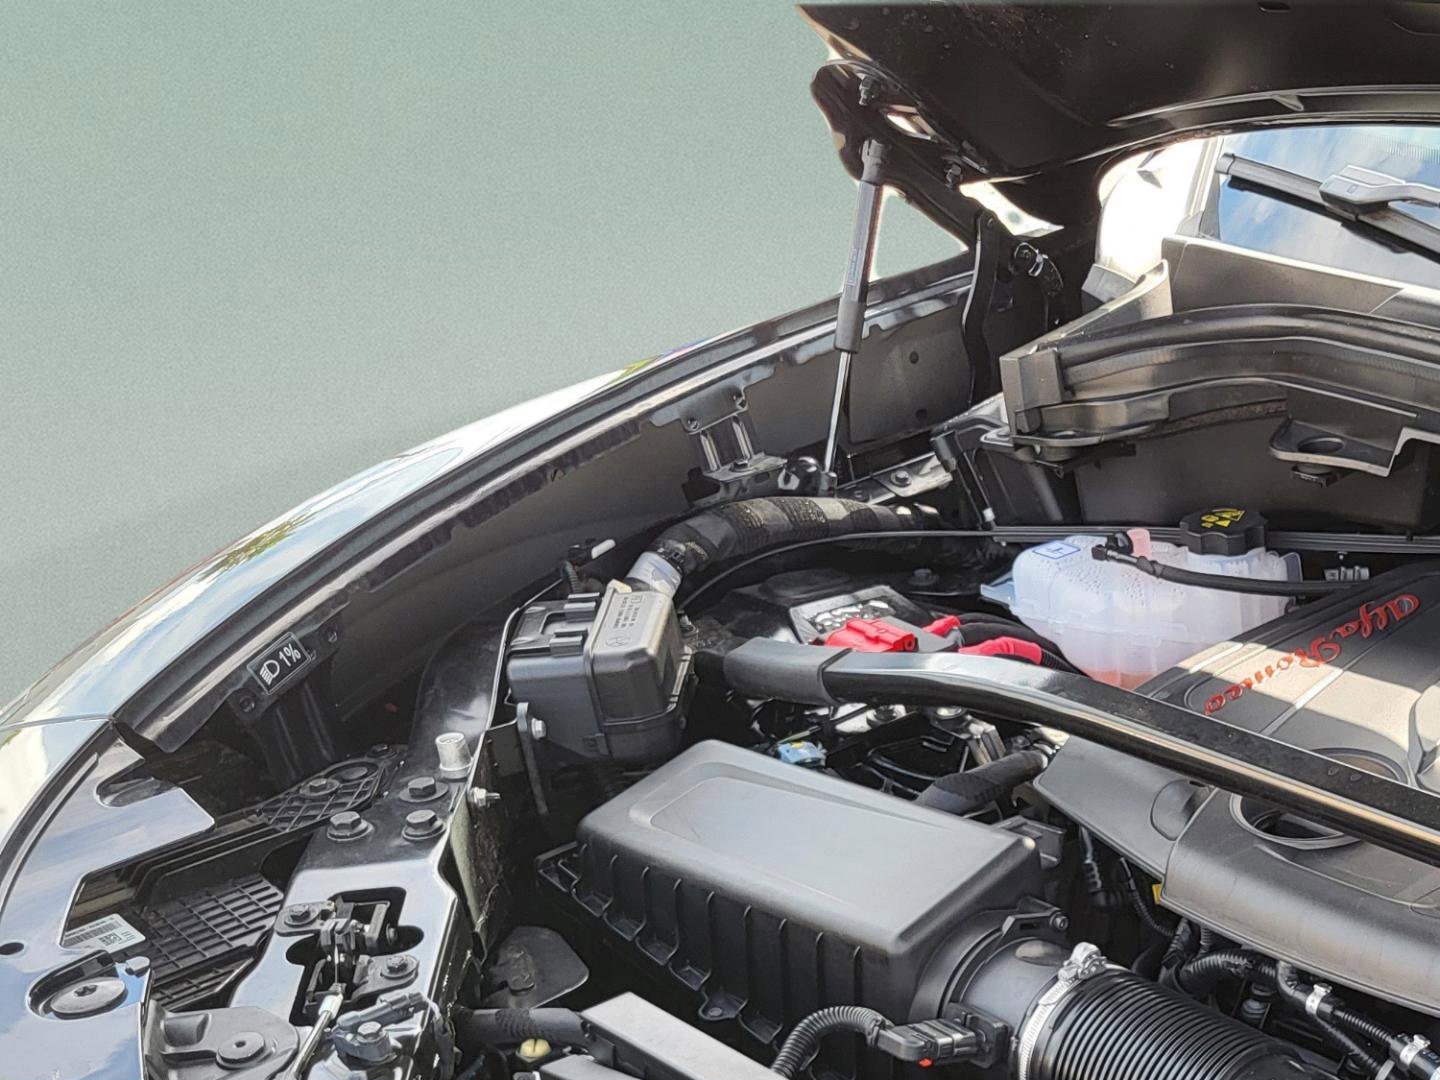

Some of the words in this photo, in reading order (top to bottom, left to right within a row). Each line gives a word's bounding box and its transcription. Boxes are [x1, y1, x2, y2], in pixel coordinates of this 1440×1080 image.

[1330, 593, 1421, 639] Alfa
[278, 642, 302, 667] 1%
[1205, 636, 1341, 715] Romeo
